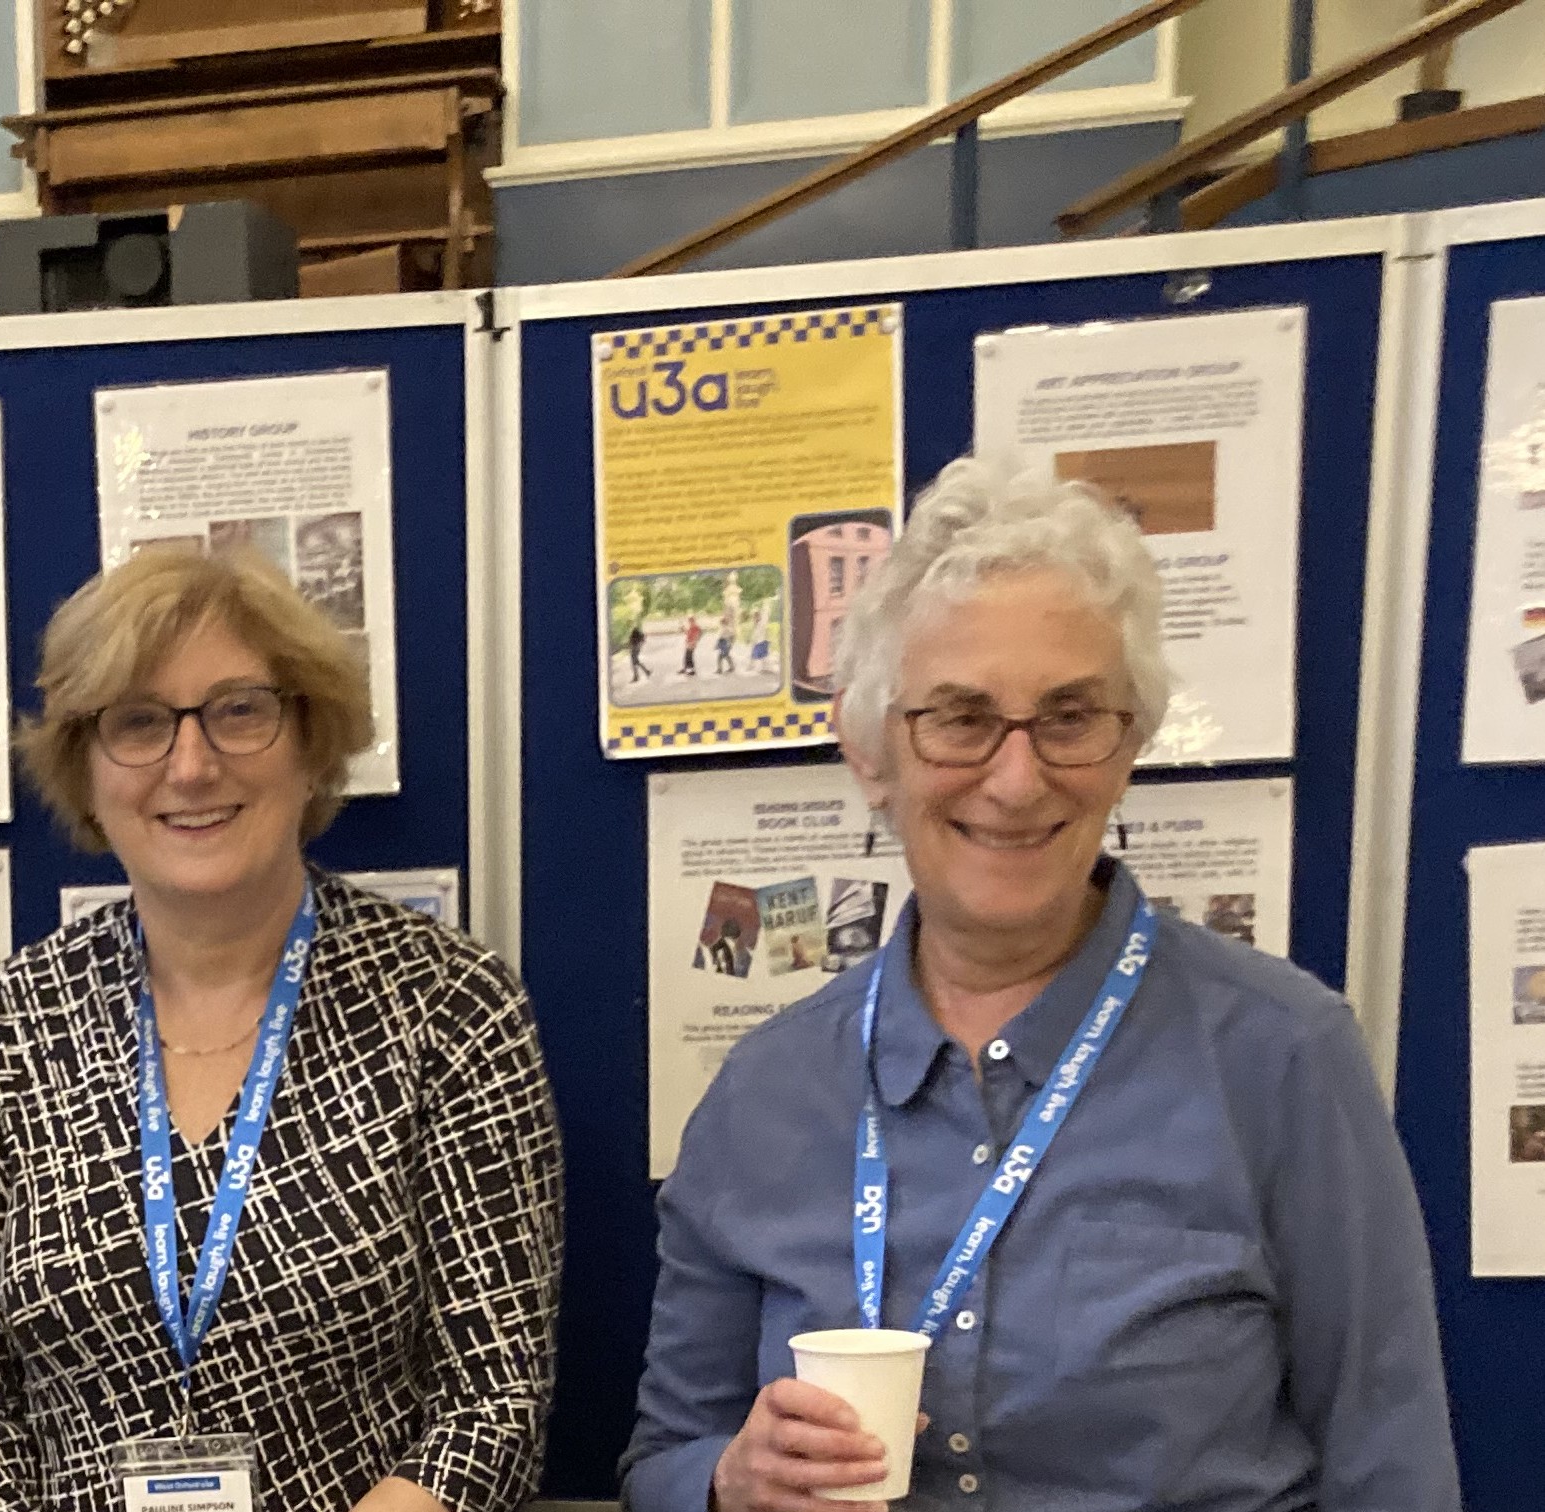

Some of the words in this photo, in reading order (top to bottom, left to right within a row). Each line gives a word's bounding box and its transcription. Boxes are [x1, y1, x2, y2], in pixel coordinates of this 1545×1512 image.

[609, 360, 729, 420] u3a
[187, 424, 246, 440] HISTORY
[249, 422, 299, 437] GROUP
[757, 816, 797, 830] BOOK
[801, 813, 841, 827] CLUB
[766, 886, 809, 911] KENT
[283, 938, 310, 984] u3a
[1116, 932, 1148, 976] u3a
[268, 1003, 289, 1032] live
[147, 1105, 162, 1132] live
[1038, 1087, 1067, 1123] live
[145, 1155, 170, 1201] u3a
[226, 1144, 254, 1190] u3a
[992, 1145, 1034, 1195] u3a
[212, 1212, 232, 1241] live
[855, 1185, 883, 1235] u3a
[187, 1501, 234, 1512] SIMPSON
